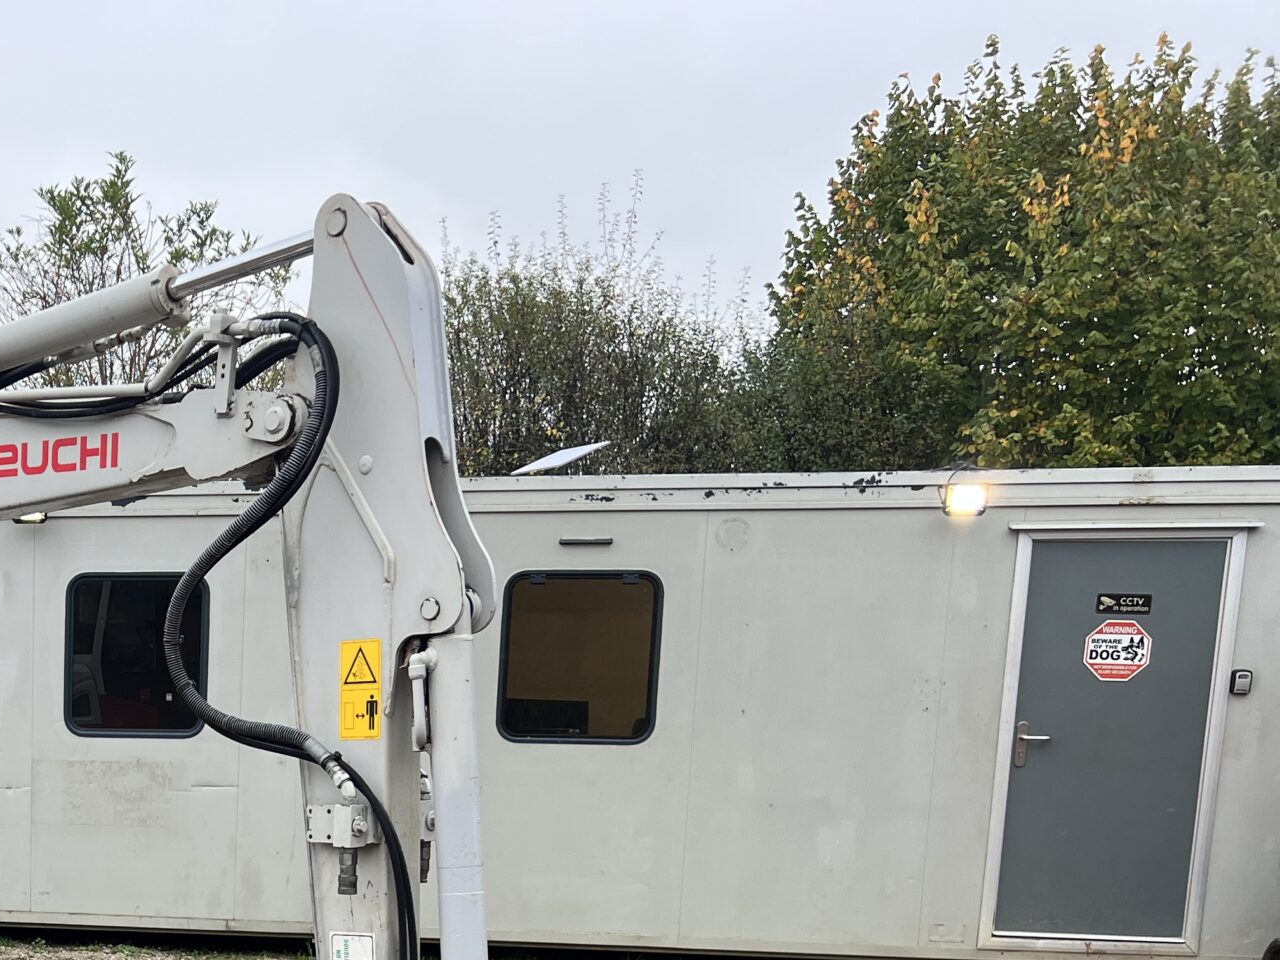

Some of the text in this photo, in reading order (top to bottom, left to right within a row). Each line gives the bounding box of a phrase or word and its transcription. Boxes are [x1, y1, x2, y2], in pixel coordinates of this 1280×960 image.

[1120, 597, 1145, 605] CCTV
[1102, 625, 1138, 634] WARNING
[1089, 650, 1121, 660] DOG
[336, 949, 341, 959] NO
